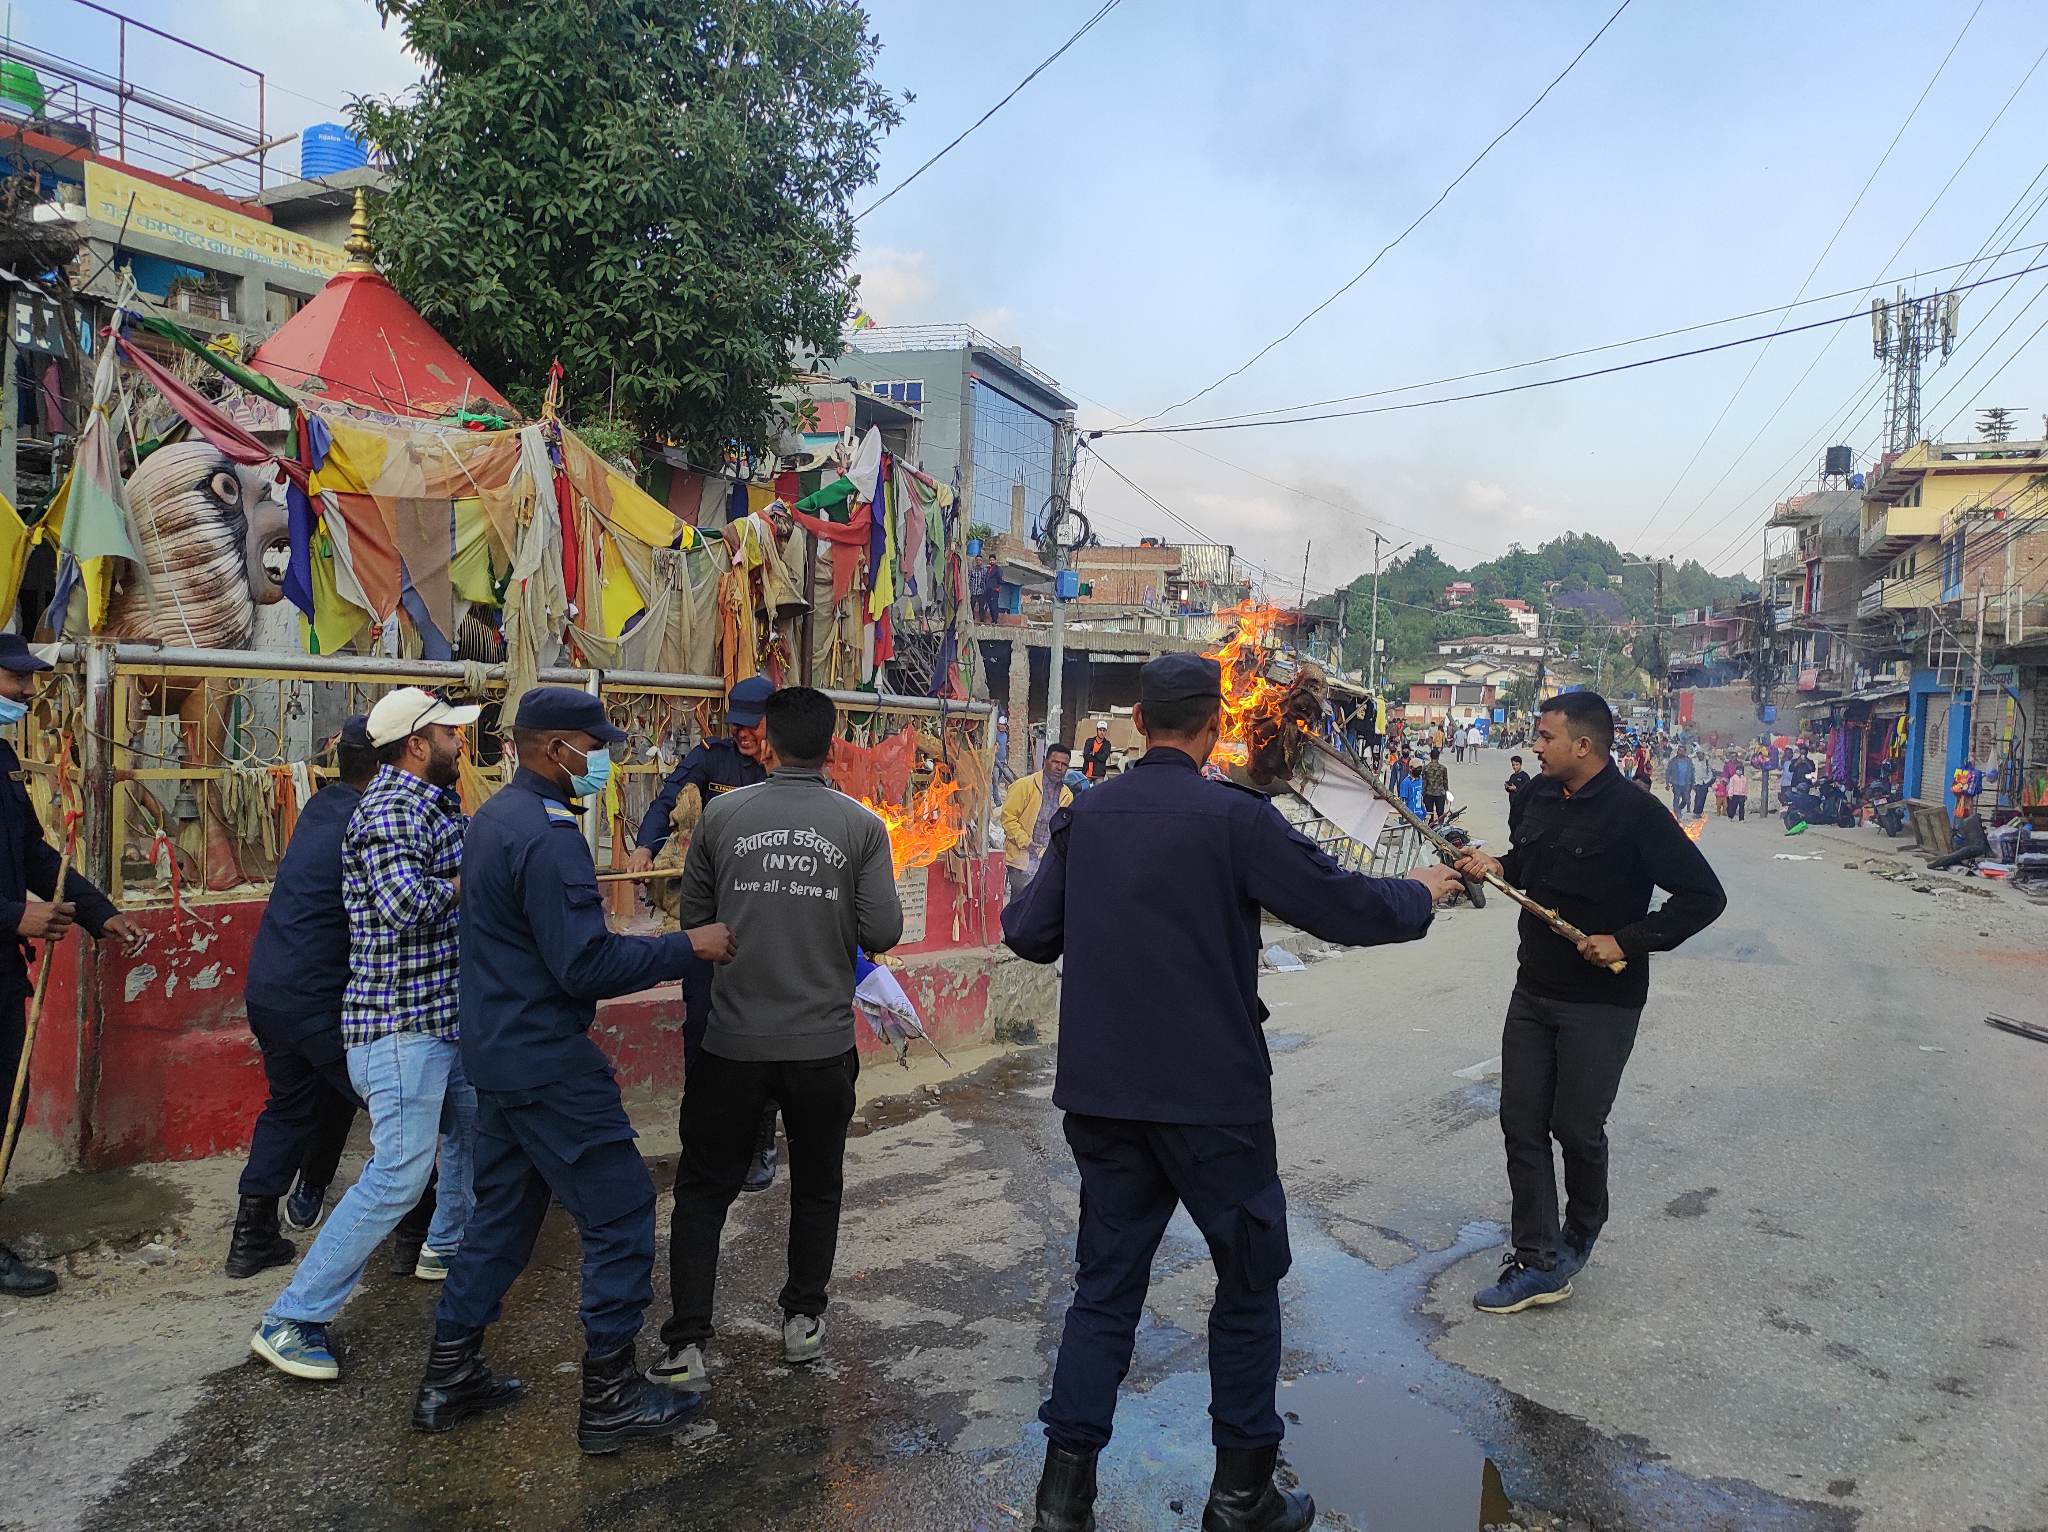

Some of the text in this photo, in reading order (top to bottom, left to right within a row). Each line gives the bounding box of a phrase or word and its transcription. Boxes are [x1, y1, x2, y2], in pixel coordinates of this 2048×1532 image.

[733, 829, 790, 858] सेवादल
[762, 852, 818, 877] (NYC)
[734, 877, 760, 892] Love
[763, 879, 780, 893] all
[789, 881, 823, 898] Serve
[824, 887, 839, 901] all
